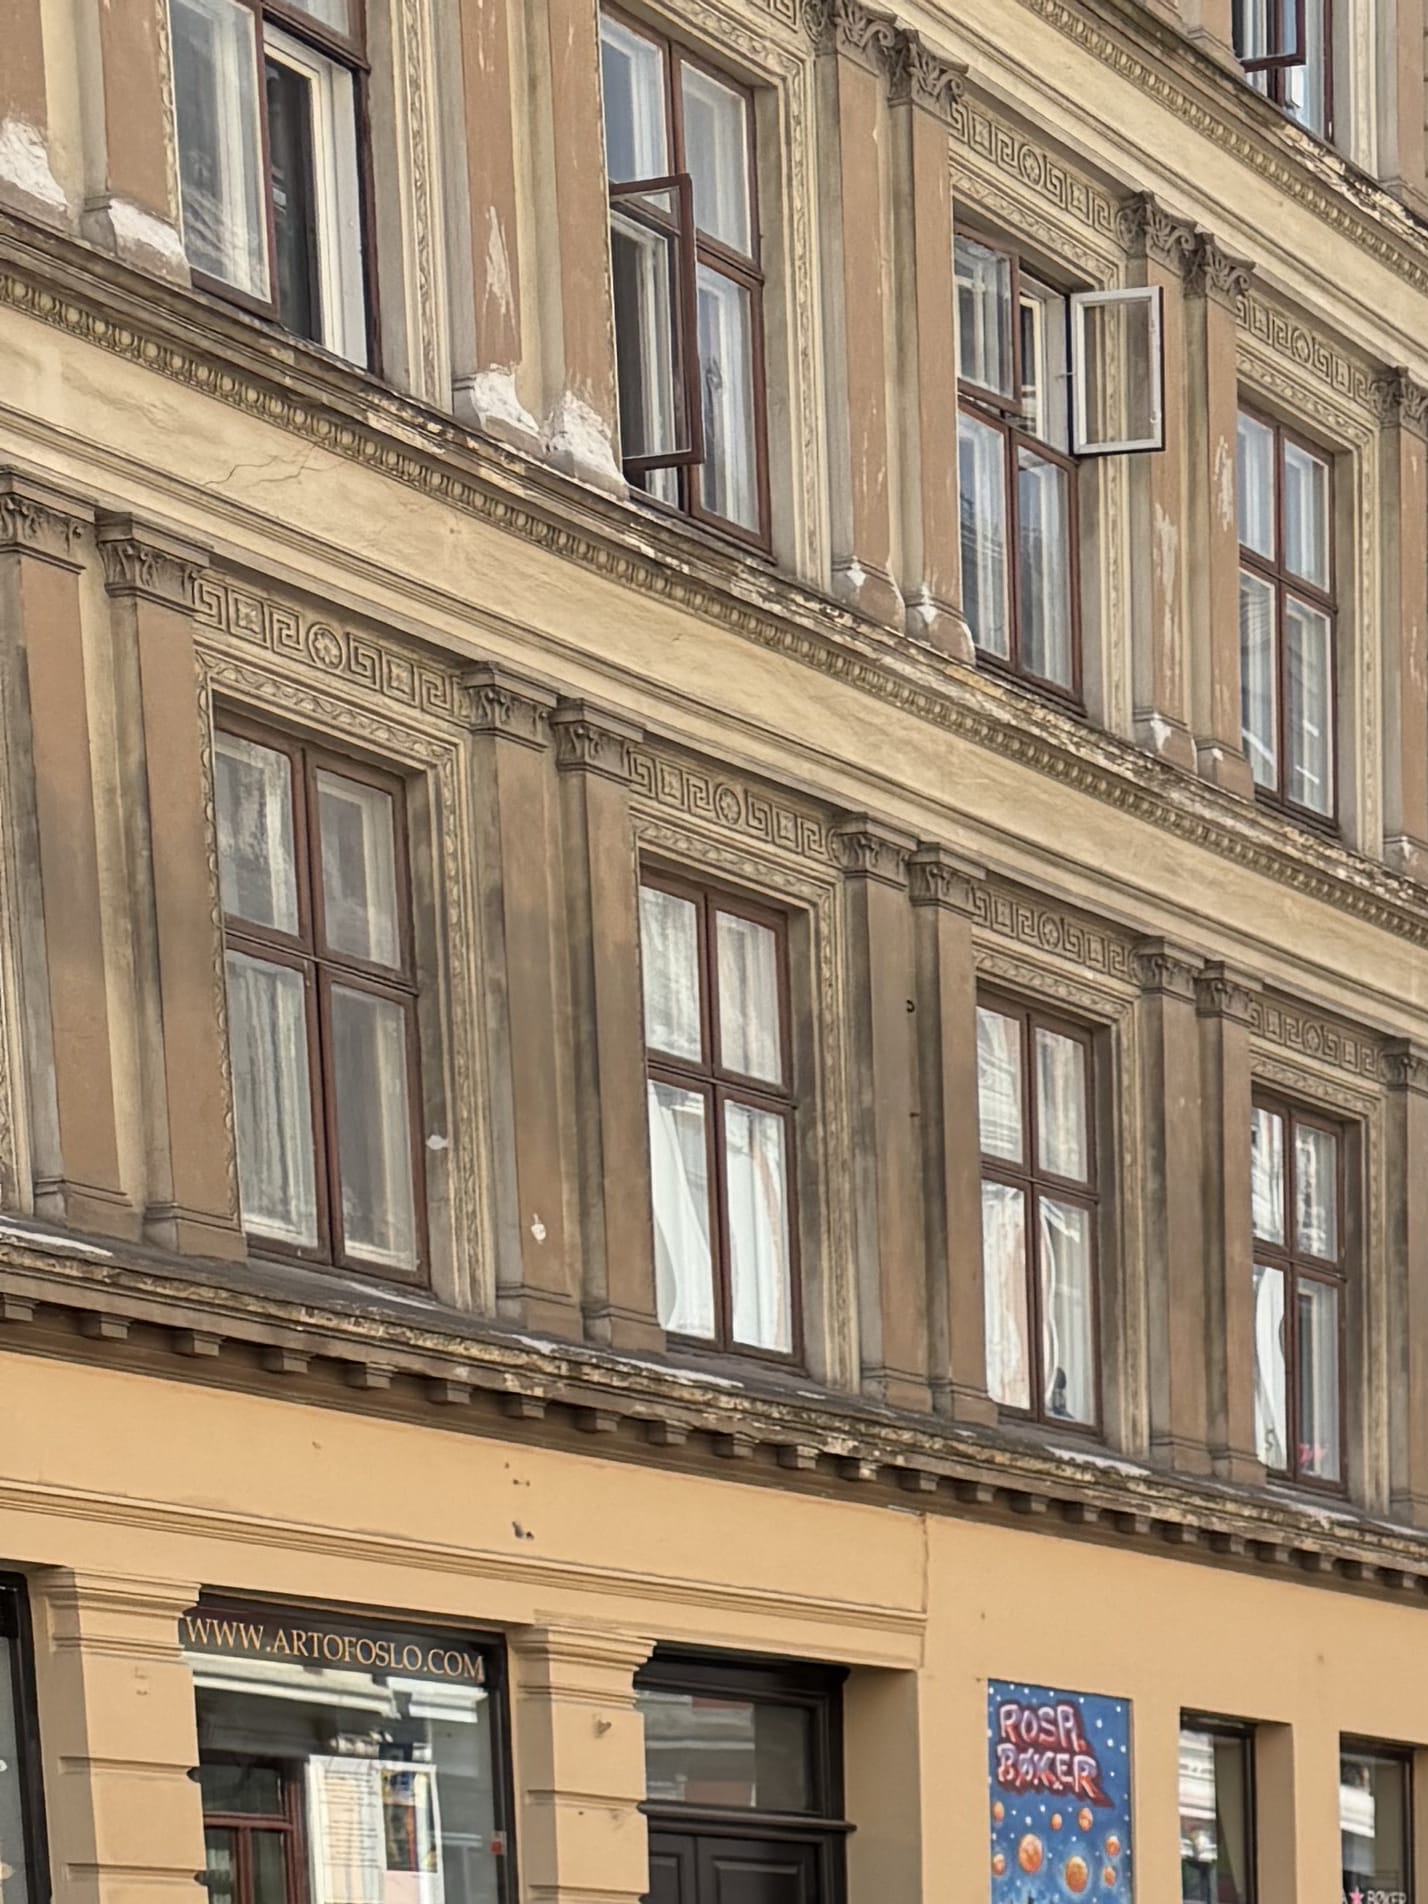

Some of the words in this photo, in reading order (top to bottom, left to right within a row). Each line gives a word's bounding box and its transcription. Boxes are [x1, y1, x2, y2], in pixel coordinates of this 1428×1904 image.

[186, 1615, 486, 1683] WWW.ARTOFOSLO.COM
[999, 1703, 1081, 1753] ROSA
[996, 1742, 1099, 1799] BØKER
